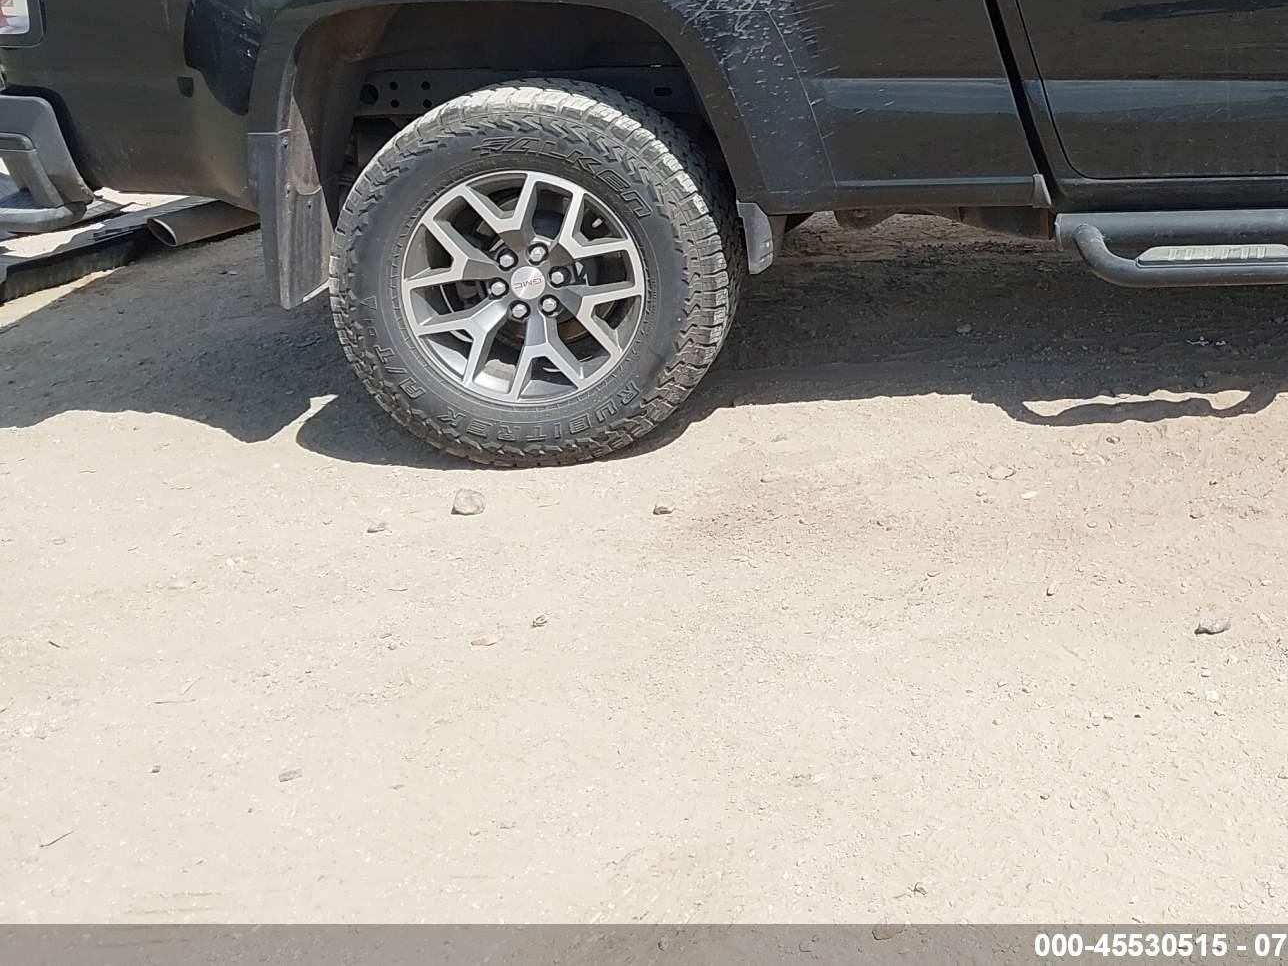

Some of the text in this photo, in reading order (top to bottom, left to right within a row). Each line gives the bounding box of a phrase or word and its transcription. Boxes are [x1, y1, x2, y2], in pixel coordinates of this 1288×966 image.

[512, 277, 542, 290] GMC
[373, 344, 642, 442] RUBITREK A/T
